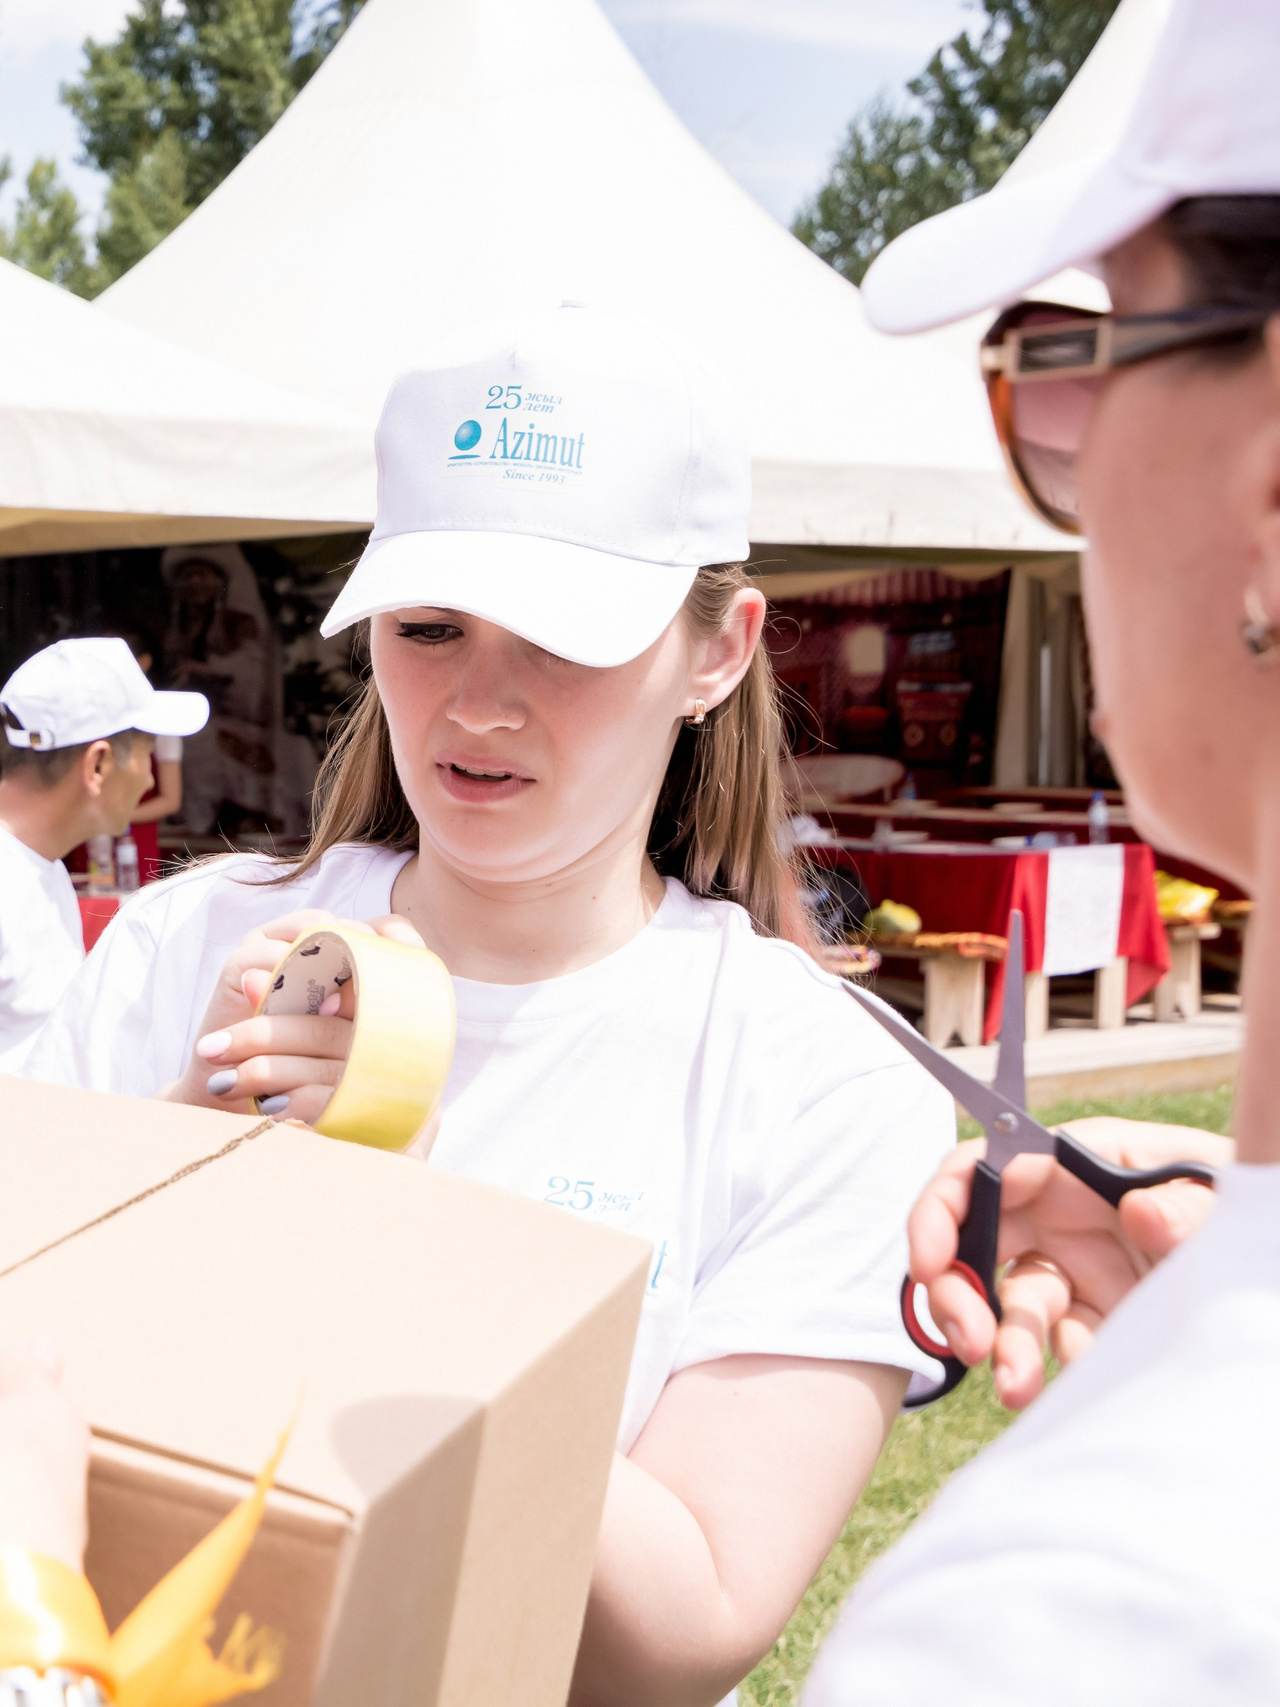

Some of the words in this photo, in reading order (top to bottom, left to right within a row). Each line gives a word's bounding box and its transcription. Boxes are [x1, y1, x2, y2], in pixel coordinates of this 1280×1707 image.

[485, 385, 523, 410] 25
[522, 403, 554, 414] лет
[489, 417, 586, 469] Azimut
[502, 468, 536, 482] Since
[538, 471, 566, 485] 1993
[543, 1175, 596, 1211] 25
